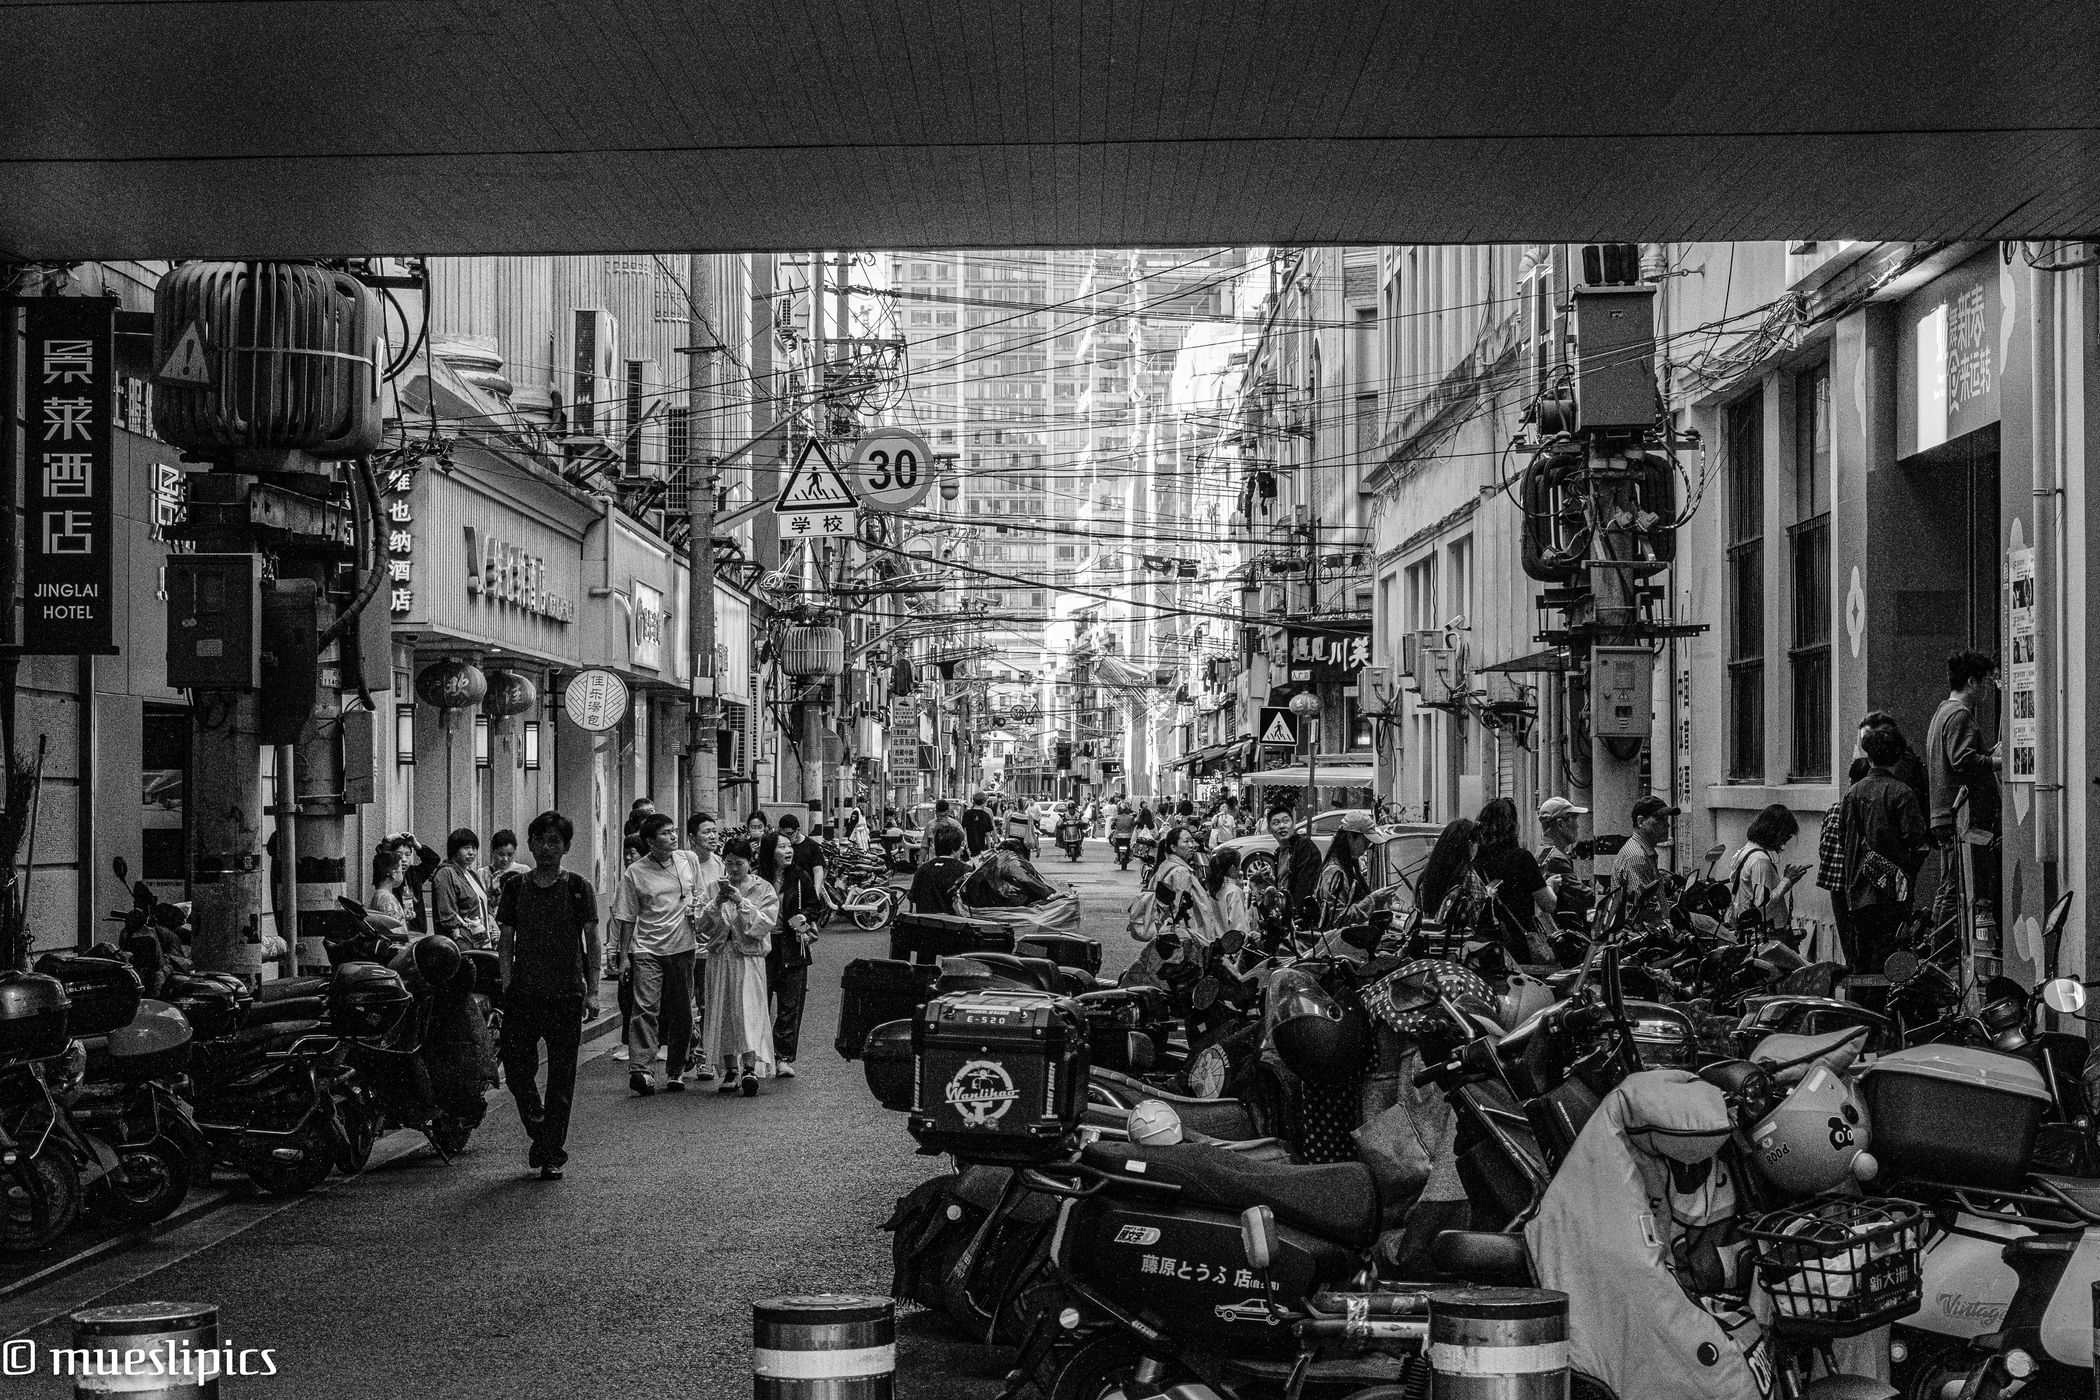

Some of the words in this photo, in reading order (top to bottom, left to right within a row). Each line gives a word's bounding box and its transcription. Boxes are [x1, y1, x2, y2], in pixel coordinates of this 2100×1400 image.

[43, 340, 93, 554] 景莱酒店
[868, 449, 917, 490] 30
[791, 515, 843, 534] 学校
[388, 468, 413, 612] 维也纳酒店
[34, 583, 98, 598] JINGLAI
[43, 605, 94, 619] HOTEL
[966, 1015, 1006, 1025] E-520
[1870, 1265, 1908, 1293] 新大洲
